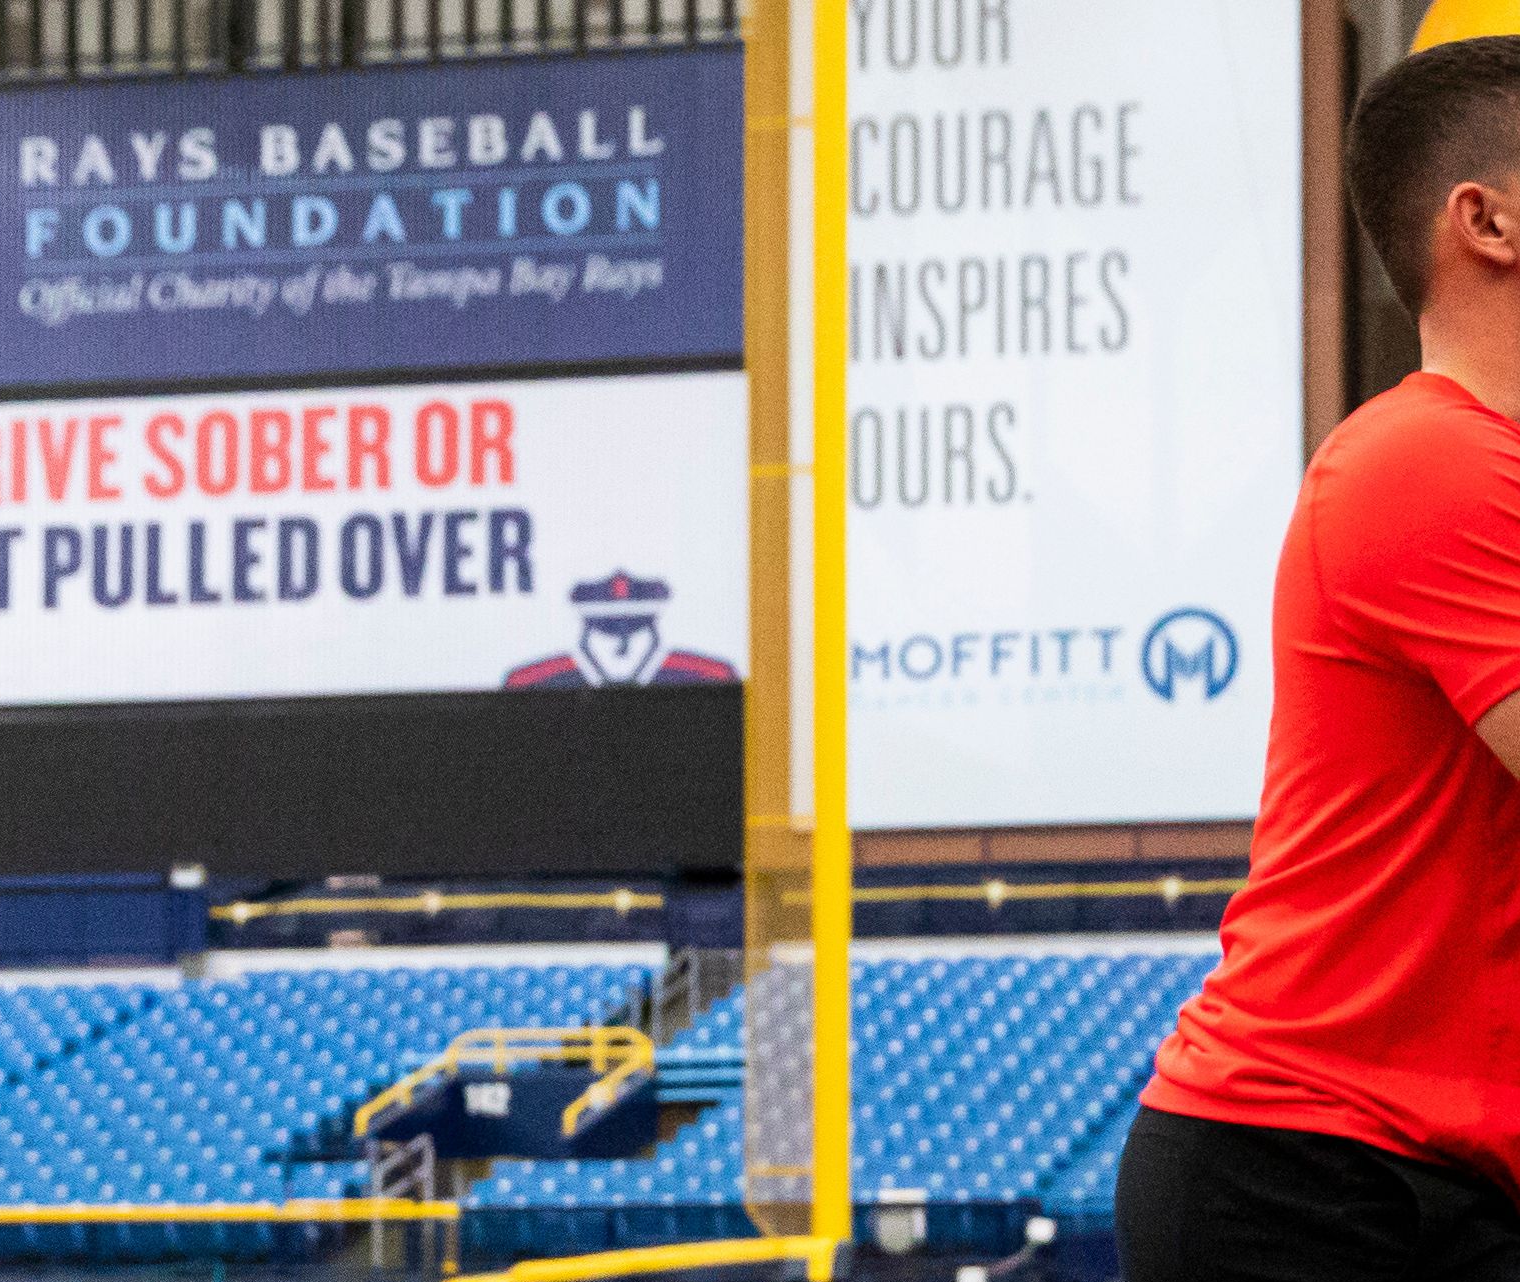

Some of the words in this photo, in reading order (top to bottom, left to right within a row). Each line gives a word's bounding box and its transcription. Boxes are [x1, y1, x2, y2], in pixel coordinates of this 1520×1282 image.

[851, 0, 1011, 72] YOUR
[17, 126, 219, 186] RAYS
[259, 104, 665, 178] BASEBALL
[848, 100, 1144, 218] COURAGE
[25, 178, 663, 258] FOUNDATION
[147, 270, 277, 318] Charity
[282, 266, 322, 316] of
[321, 264, 376, 302] the
[385, 260, 501, 306] Tampa
[509, 256, 578, 302] Bay
[581, 252, 665, 298] Rays
[847, 248, 1131, 364] INSPIRES
[143, 404, 391, 499] SOBER
[414, 398, 515, 487] OR
[849, 402, 1034, 511] OURS.
[41, 512, 319, 608] PULLED
[338, 507, 533, 602] OVER
[849, 626, 1123, 682] MOFFITT
